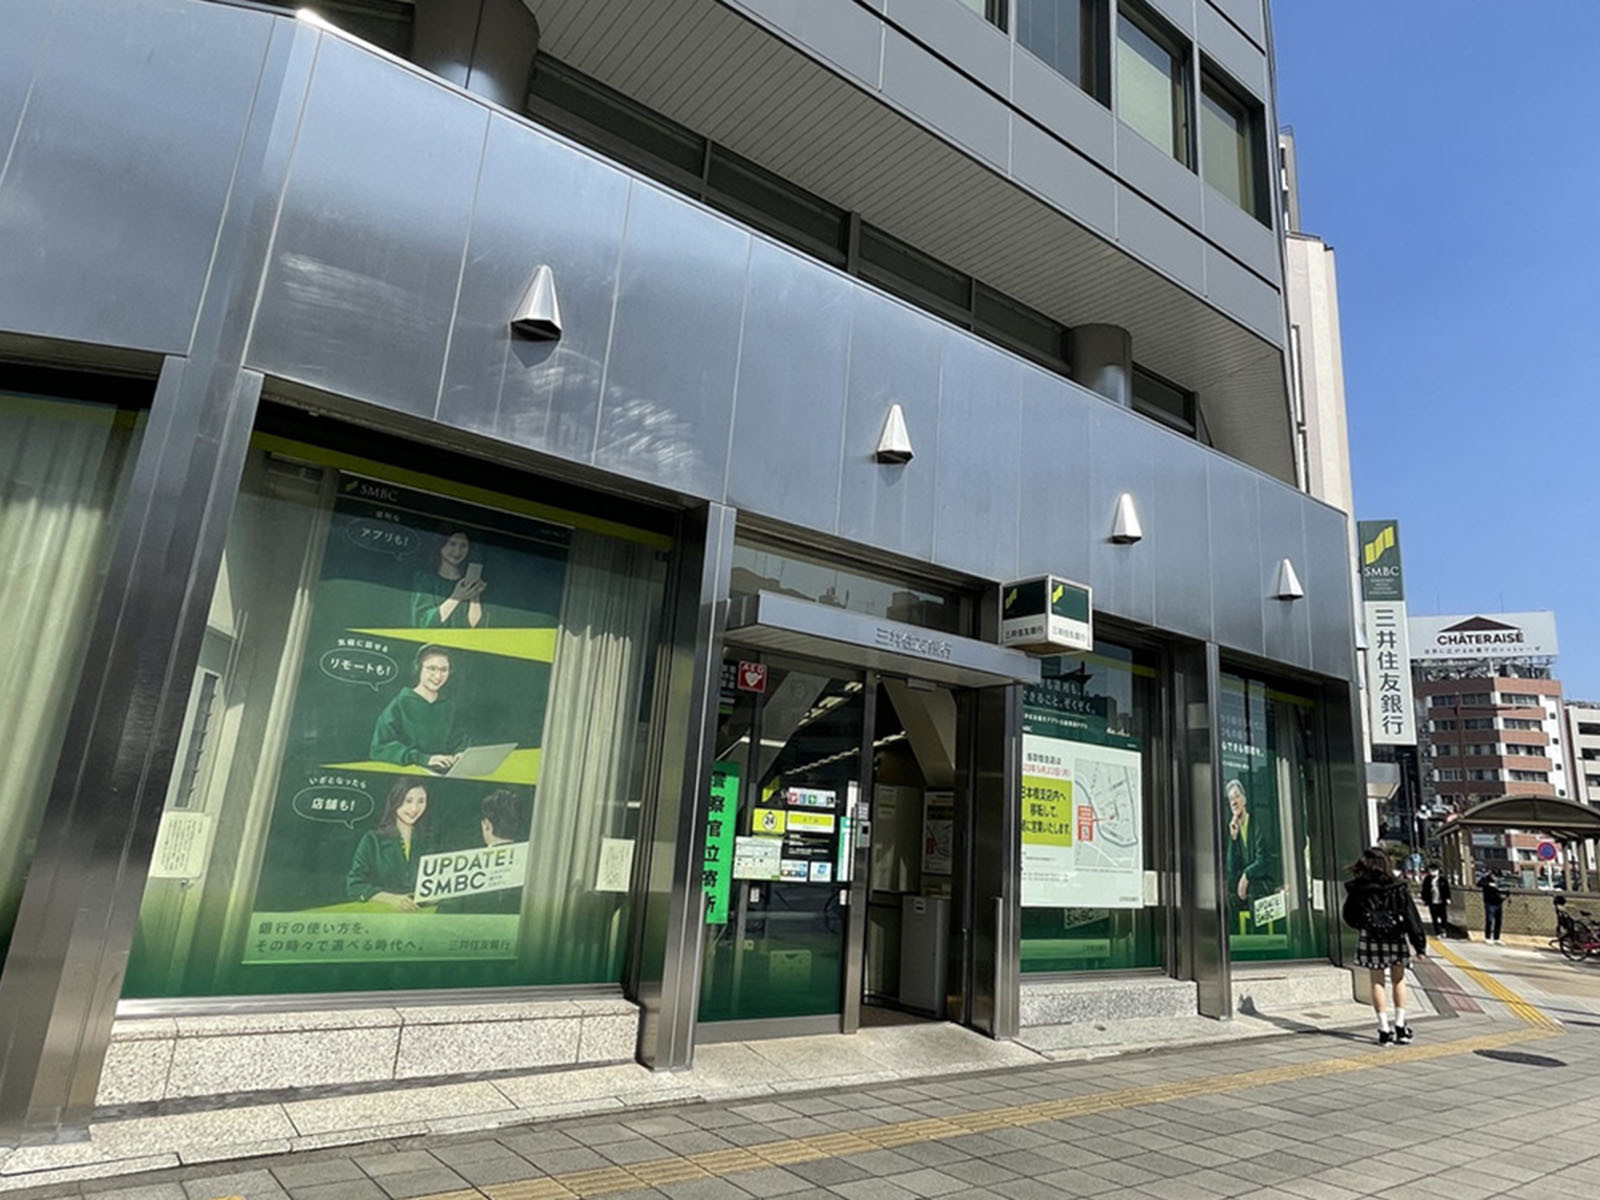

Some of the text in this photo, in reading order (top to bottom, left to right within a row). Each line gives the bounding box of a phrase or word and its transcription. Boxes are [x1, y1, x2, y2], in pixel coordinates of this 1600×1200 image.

[360, 483, 399, 501] SMBC
[1363, 566, 1400, 577] SMBC
[742, 663, 765, 674] AED
[1375, 608, 1404, 735] 三井住友銀行
[422, 848, 515, 877] UPDATE!
[419, 871, 486, 898] SMBC
